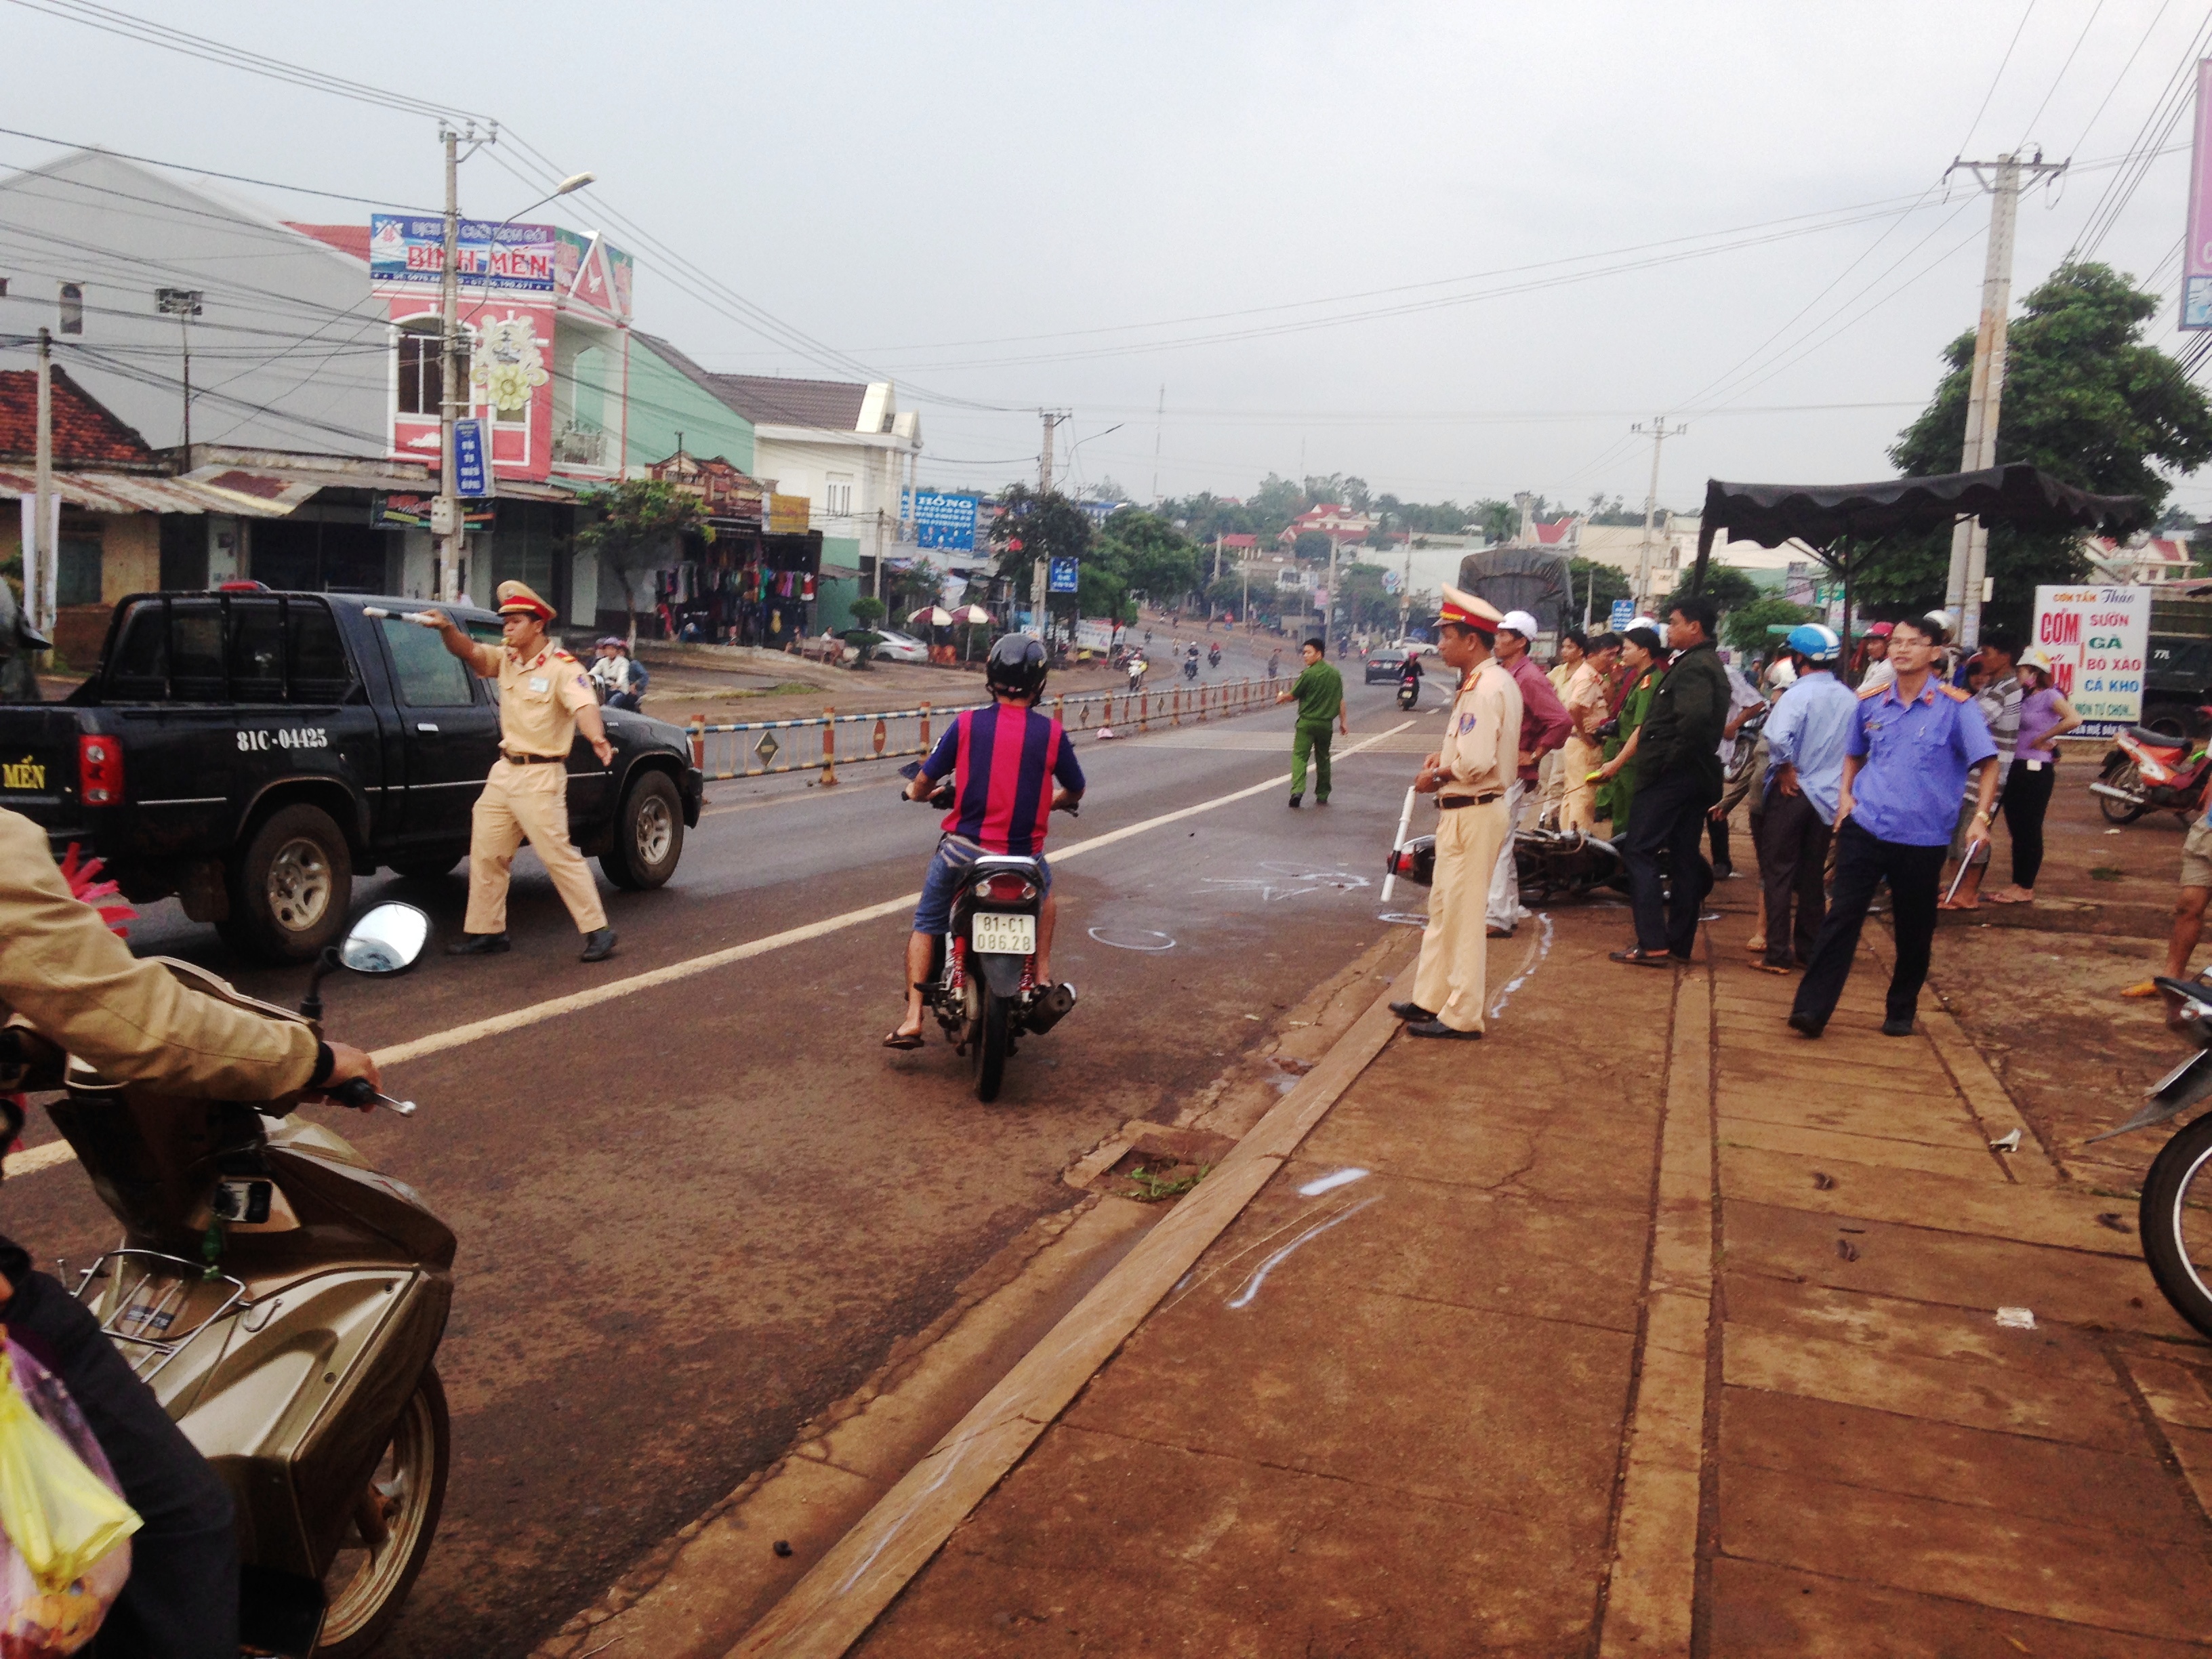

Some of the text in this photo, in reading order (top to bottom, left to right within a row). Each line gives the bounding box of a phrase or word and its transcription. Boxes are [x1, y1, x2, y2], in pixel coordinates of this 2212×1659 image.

[491, 246, 550, 277] MẾN
[2040, 608, 2082, 644] CƠM
[2084, 677, 2140, 693] CÁ KHO
[2, 754, 46, 790] MẾN
[983, 916, 1024, 934] 81-C1
[977, 933, 1031, 952] 086.28
